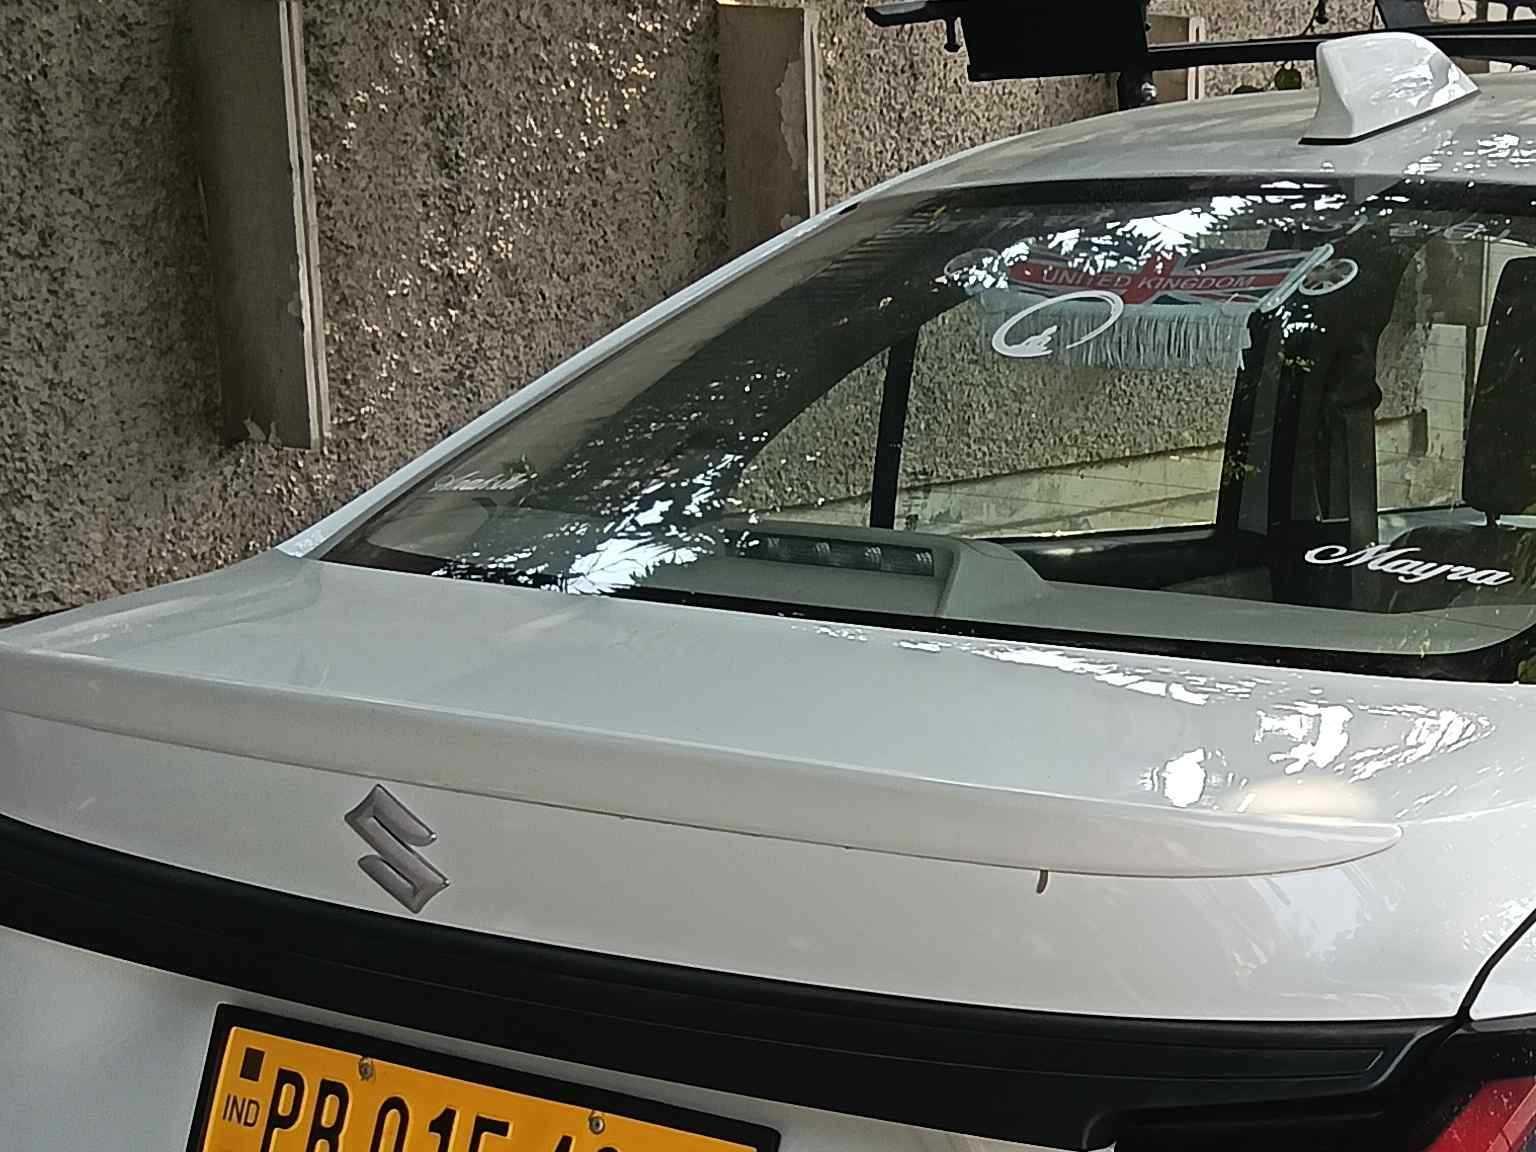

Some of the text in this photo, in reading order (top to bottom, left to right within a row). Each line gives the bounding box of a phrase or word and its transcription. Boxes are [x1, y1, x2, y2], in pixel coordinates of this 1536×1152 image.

[1043, 268, 1256, 290] UNITED KINGDOM
[1304, 543, 1515, 586] Mayra
[221, 1092, 260, 1129] IND
